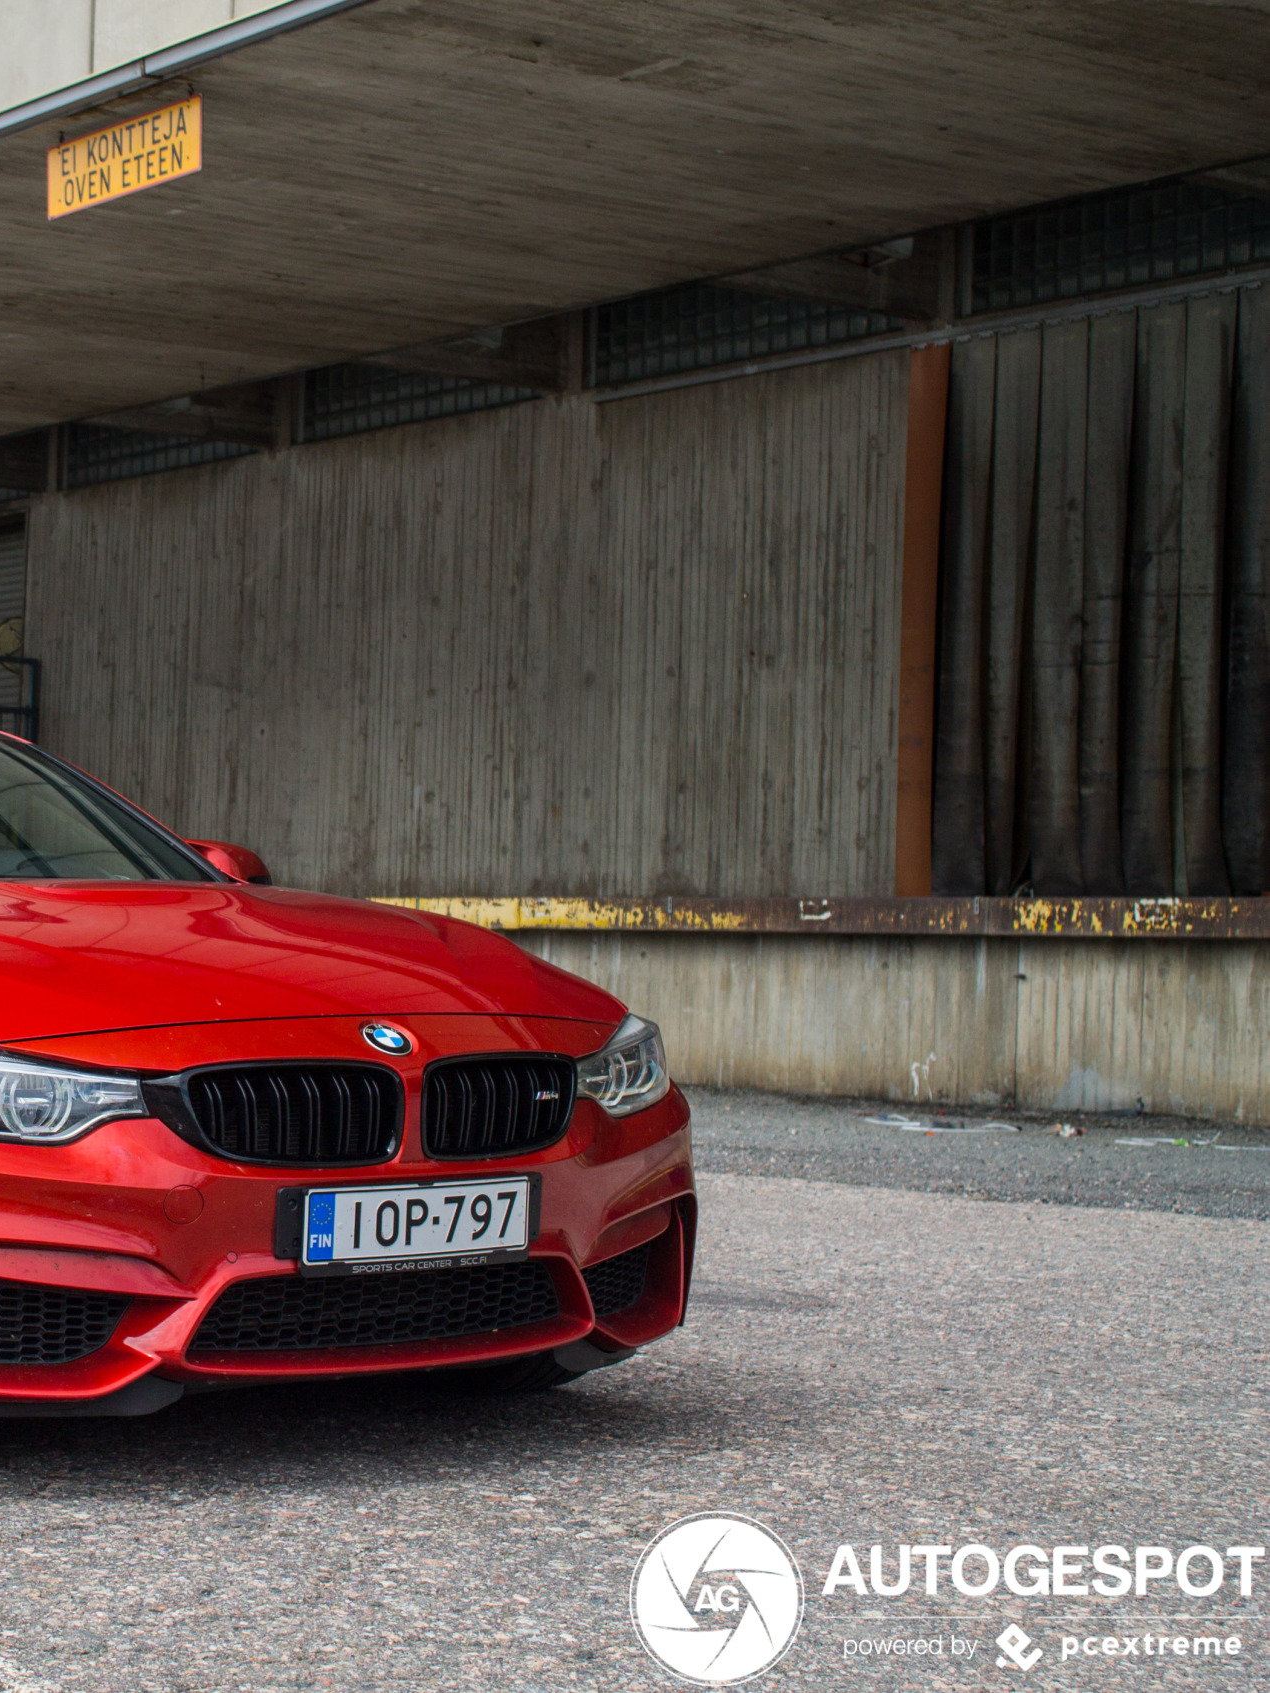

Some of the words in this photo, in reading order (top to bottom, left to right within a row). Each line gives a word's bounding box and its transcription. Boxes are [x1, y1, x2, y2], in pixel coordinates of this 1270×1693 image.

[61, 145, 77, 177] EI
[87, 106, 187, 168] KONTTEJA
[64, 165, 110, 207] OVEN
[122, 141, 183, 189] ETEEN
[310, 1233, 332, 1249] FIN
[353, 1191, 518, 1249] IOP-797
[352, 1263, 393, 1274] SPORTS
[394, 1261, 416, 1272] CAR
[417, 1259, 452, 1270] CENTER
